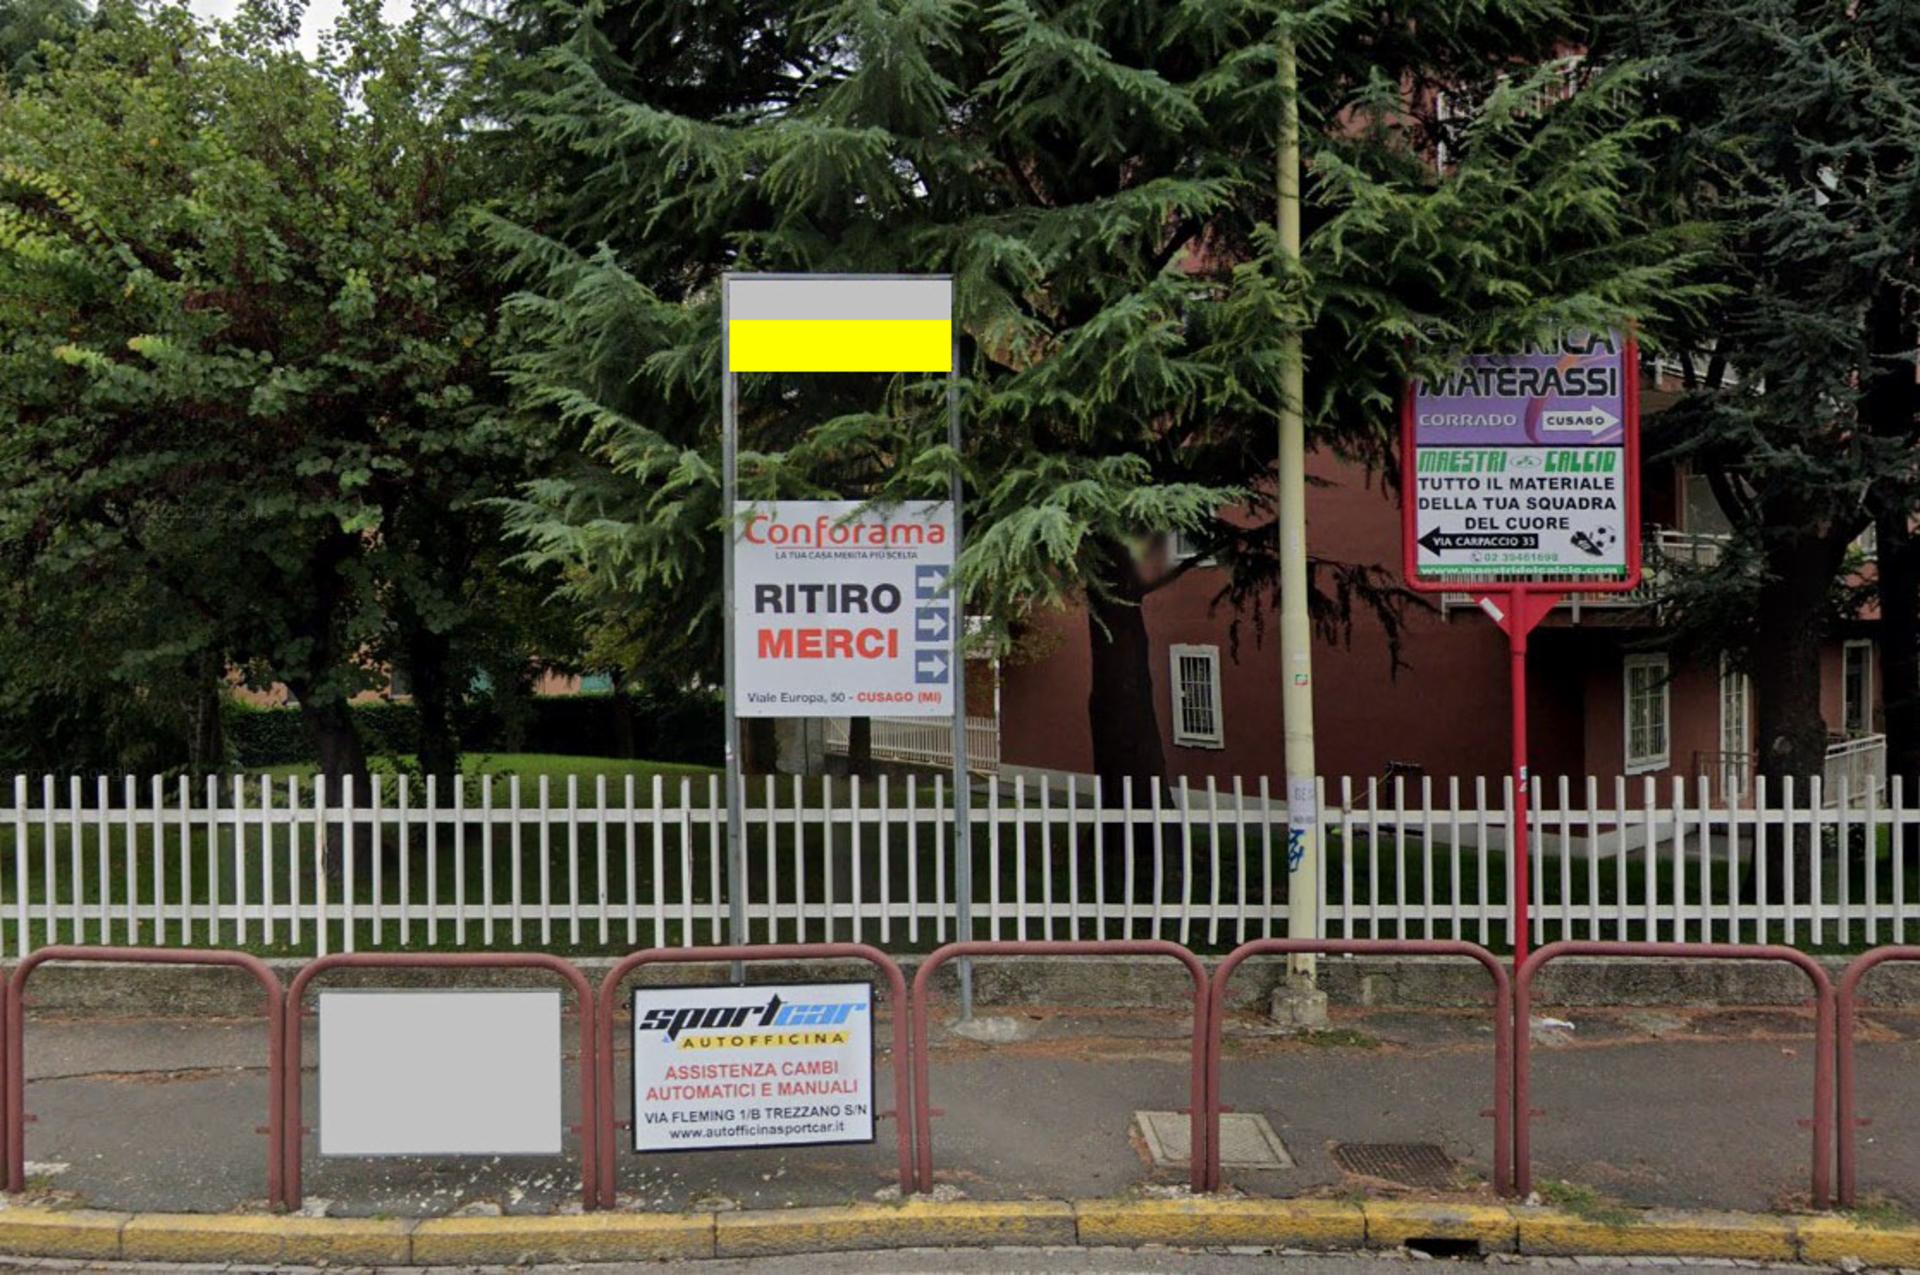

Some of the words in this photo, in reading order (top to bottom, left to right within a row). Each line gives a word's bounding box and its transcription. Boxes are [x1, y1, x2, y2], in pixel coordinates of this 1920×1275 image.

[1419, 366, 1617, 397] MATERASSI
[1419, 413, 1517, 427] CORRADO
[1546, 415, 1605, 426] CUSAGO
[1418, 450, 1507, 473] MAESTRI
[1544, 450, 1616, 473] CALCIO
[1419, 477, 1480, 491] TUTTO
[1487, 477, 1503, 491] IL
[1509, 477, 1615, 491] MATERIALE
[1418, 497, 1477, 510] DELLA
[1483, 497, 1520, 510] TUA
[1526, 497, 1617, 511] SQUADRA
[744, 515, 946, 549] Conforama
[1464, 517, 1501, 530] DEL
[1505, 517, 1570, 530] CUORE
[1432, 537, 1452, 546] VIA
[1455, 537, 1519, 546] CARPACCIO
[1522, 537, 1536, 546] 33
[775, 552, 787, 560] LA
[789, 552, 807, 560] TUA
[808, 552, 833, 560] CASA
[834, 552, 868, 560] MERITA
[886, 552, 918, 560] SCELTA
[1484, 552, 1498, 562] 02
[754, 583, 902, 614] RITIRO
[757, 628, 899, 659] MERCI
[747, 692, 777, 703] Viale
[781, 692, 828, 705] Europa,
[830, 692, 845, 703] 50
[857, 692, 914, 703] CUSAGO
[917, 692, 942, 704] (MI)
[639, 992, 867, 1042] sportcar
[682, 1032, 845, 1049] AUTOFFICINA
[665, 1062, 777, 1081] ASSISTENZA
[782, 1060, 839, 1077] CAMBI
[646, 1084, 756, 1101] AUTOMATICI
[761, 1083, 773, 1097] E
[778, 1079, 859, 1096] MANUALI
[645, 1111, 669, 1124] VIA
[672, 1109, 735, 1123] FLEMING
[740, 1108, 762, 1121] 1/B
[766, 1106, 841, 1120] TREZZANO
[843, 1104, 868, 1116] S/N
[669, 1121, 845, 1139] www.autofficinasportcar.it
